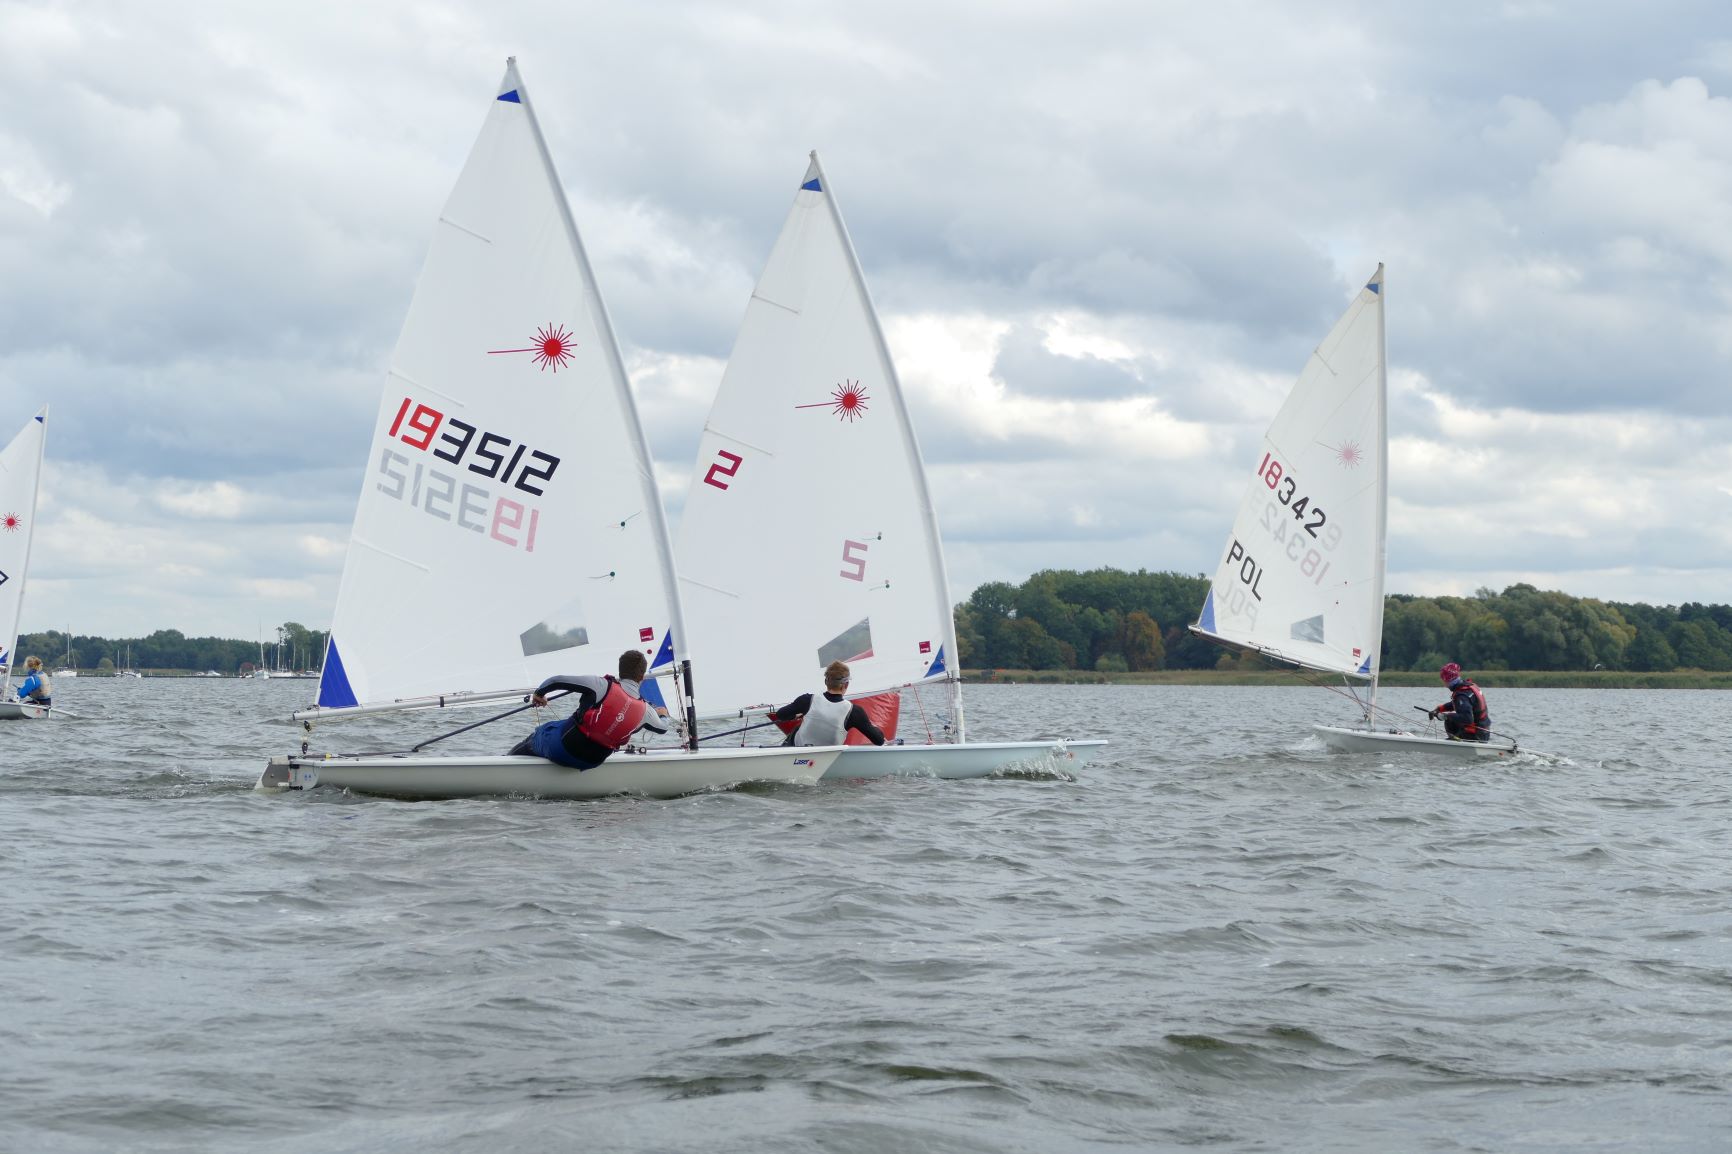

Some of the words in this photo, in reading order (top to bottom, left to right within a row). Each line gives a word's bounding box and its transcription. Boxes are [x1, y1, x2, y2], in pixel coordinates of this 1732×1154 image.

[389, 397, 560, 496] 193512
[704, 450, 743, 490] 2
[1226, 539, 1263, 601] POL
